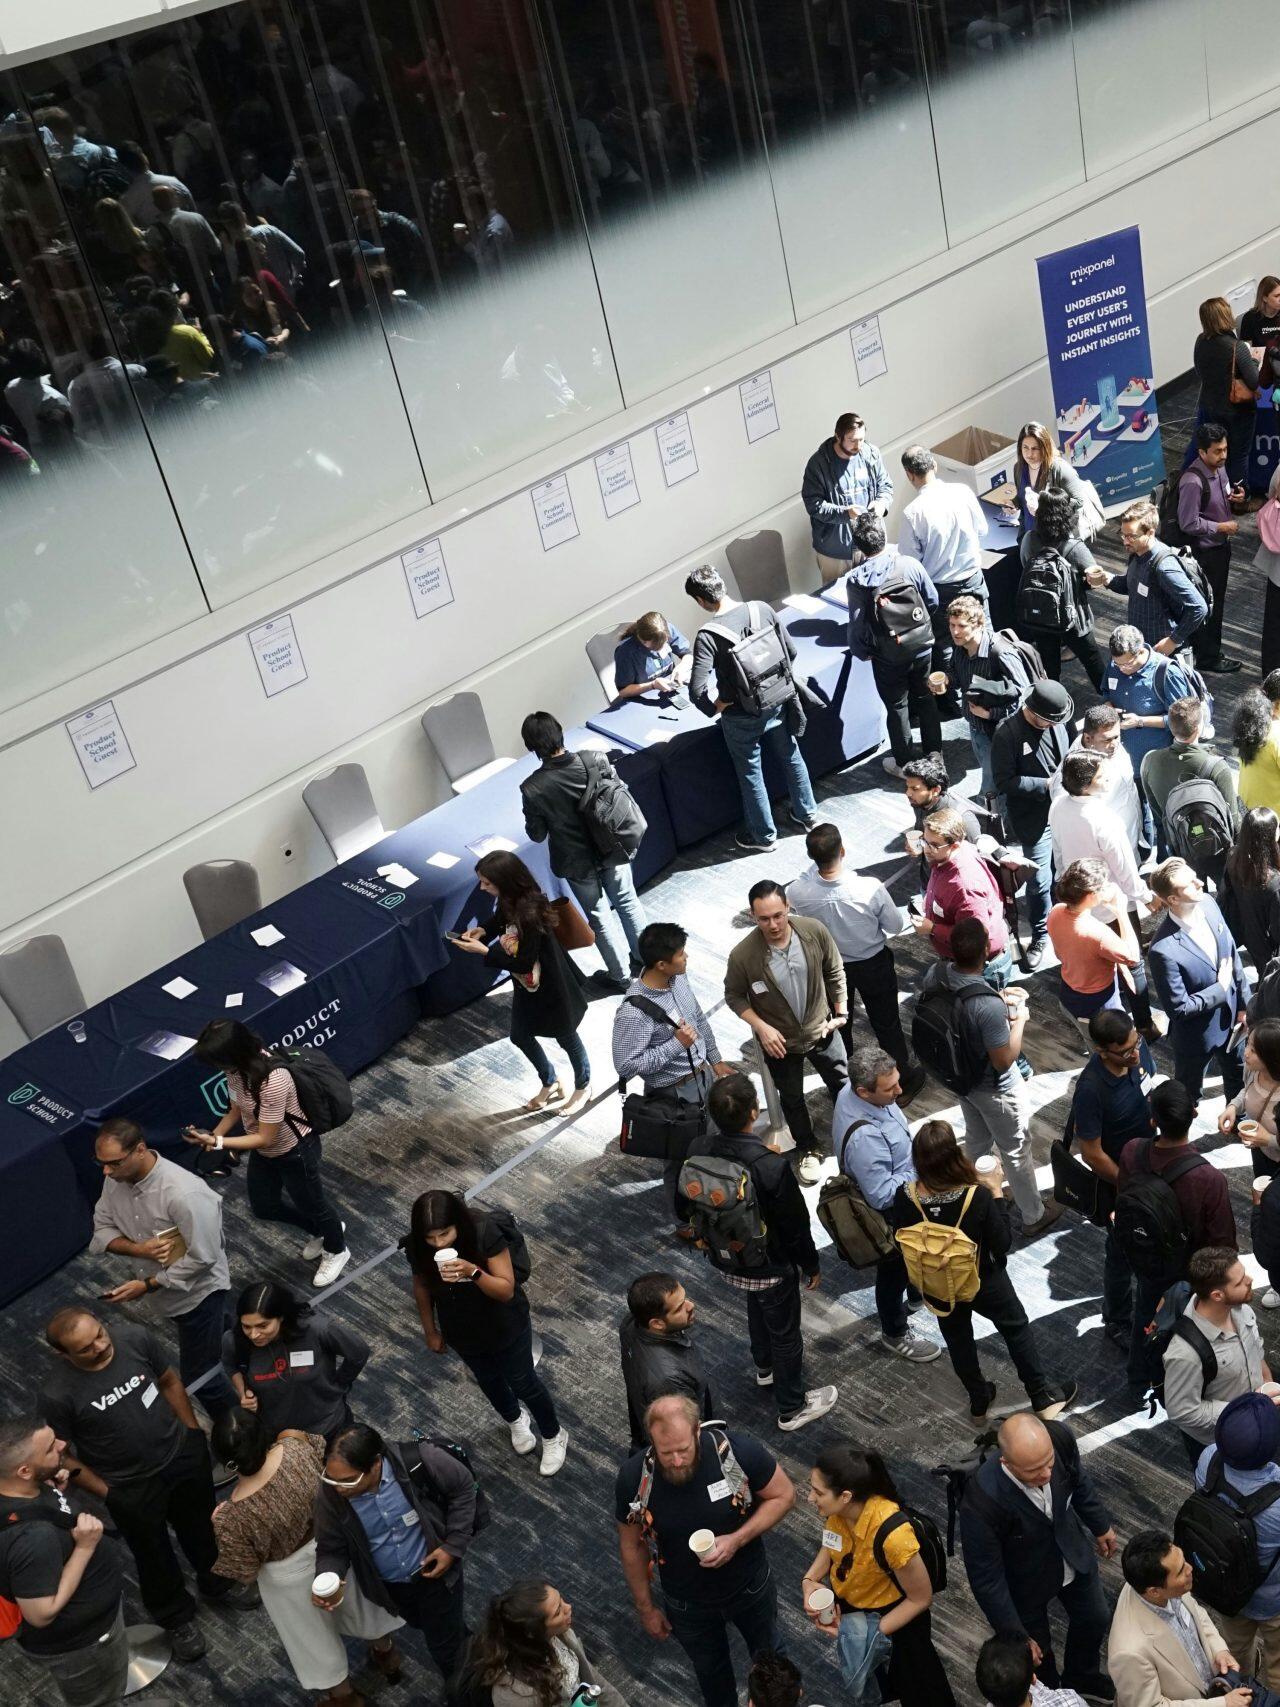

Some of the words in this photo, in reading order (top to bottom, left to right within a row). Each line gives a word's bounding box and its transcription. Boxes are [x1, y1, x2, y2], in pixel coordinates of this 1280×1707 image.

[1070, 254, 1116, 279] mixpanel
[1064, 285, 1126, 313] UNDERSTAND
[1067, 310, 1095, 329] EVERY
[1097, 300, 1128, 318] USER'S
[1065, 322, 1108, 345] JOURNEY
[1109, 313, 1133, 328] WITH
[1061, 340, 1098, 362] INSTANT
[1100, 326, 1141, 348] INSIGHTS
[747, 395, 769, 411] General
[606, 469, 627, 483] Product
[609, 475, 626, 487] School
[543, 501, 565, 516] Product
[546, 507, 565, 521] School
[541, 512, 573, 530] Community
[413, 566, 440, 583] Product
[417, 574, 440, 590] School
[420, 581, 441, 595] Guest
[262, 642, 292, 662] Product
[267, 650, 292, 667] School
[271, 659, 293, 673] Guest
[83, 730, 117, 751] Product
[89, 738, 117, 757] School
[93, 747, 118, 763] Guest
[342, 882, 379, 899] PRODUCT
[357, 878, 387, 893] SCHOOL
[268, 998, 341, 1051] RODUCT
[302, 1027, 337, 1049] OOL
[26, 1103, 58, 1124] SCHOOL
[37, 1095, 75, 1120] PRODUCT
[90, 1374, 146, 1411] Value.
